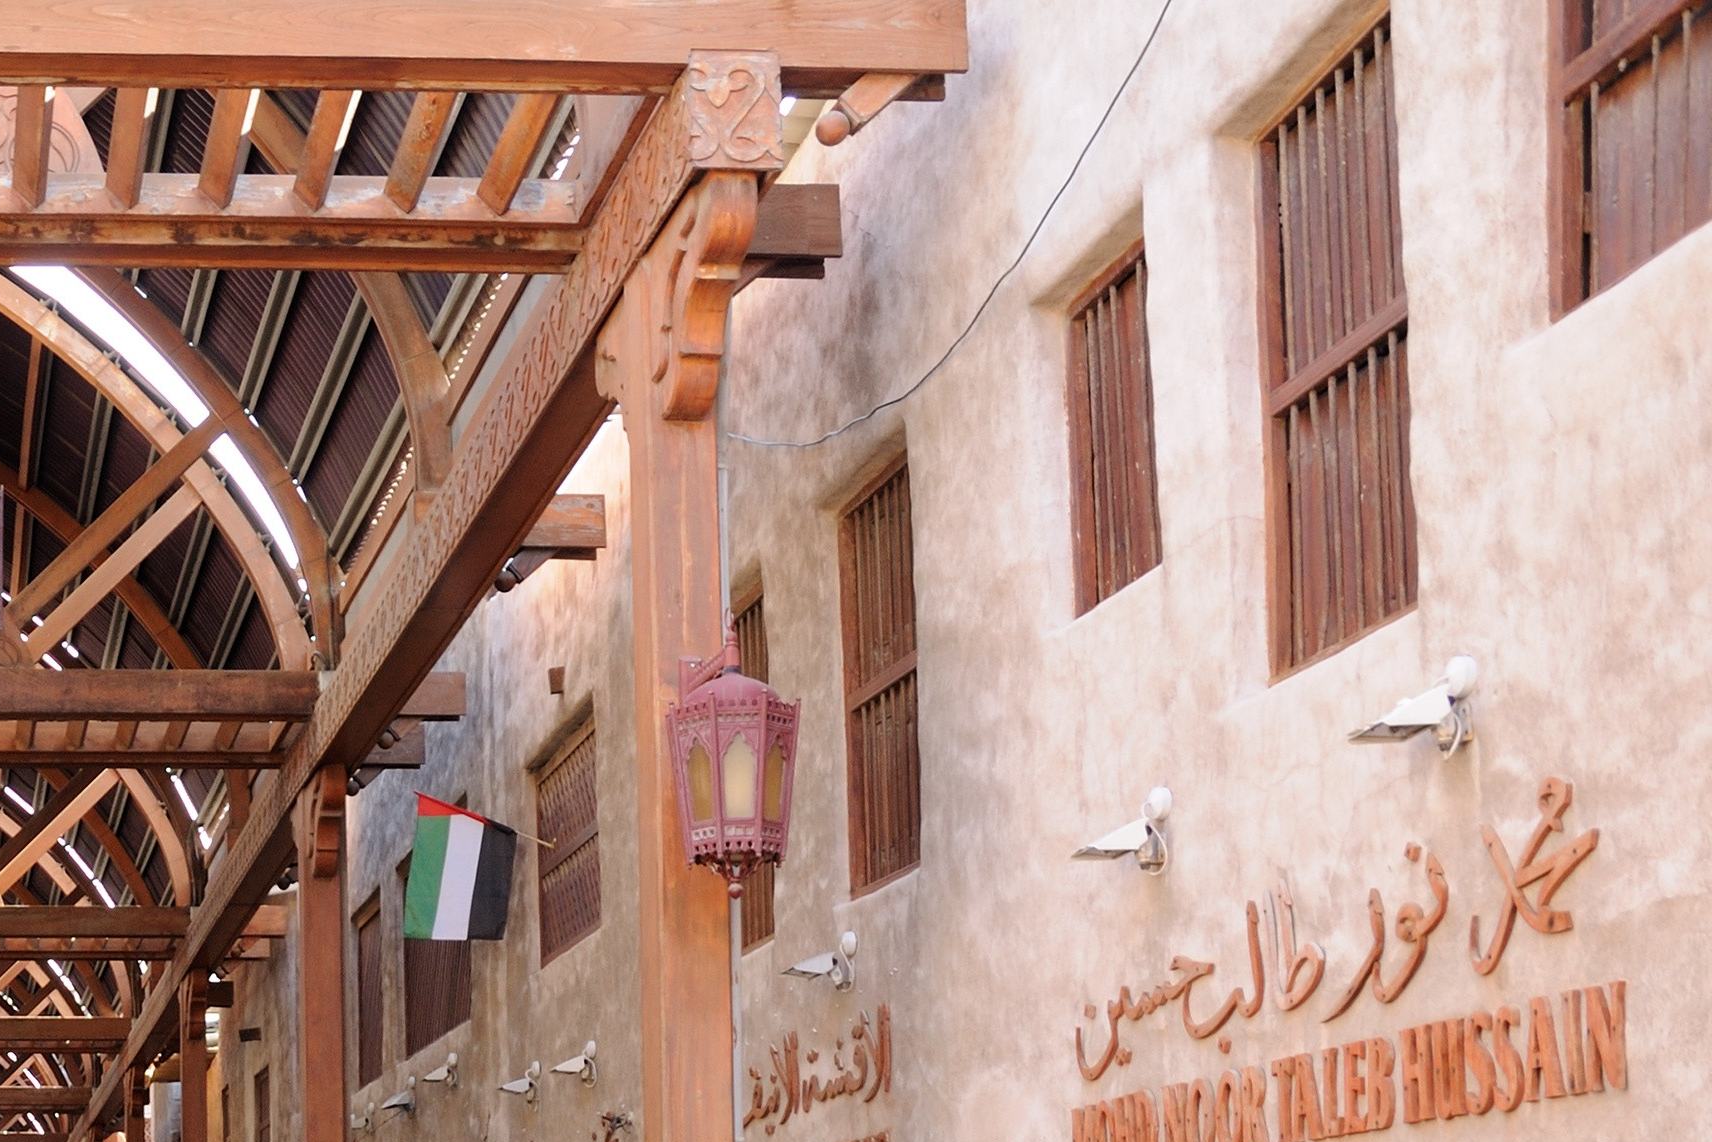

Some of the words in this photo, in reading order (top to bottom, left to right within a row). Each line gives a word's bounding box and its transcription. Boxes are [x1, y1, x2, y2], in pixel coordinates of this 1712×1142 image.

[1183, 868, 1326, 1053] طالب
[1322, 842, 1449, 1023] نور
[1470, 776, 1600, 976] محمد
[1076, 954, 1214, 1081] حسين
[1399, 980, 1628, 1126] HUSSAIN
